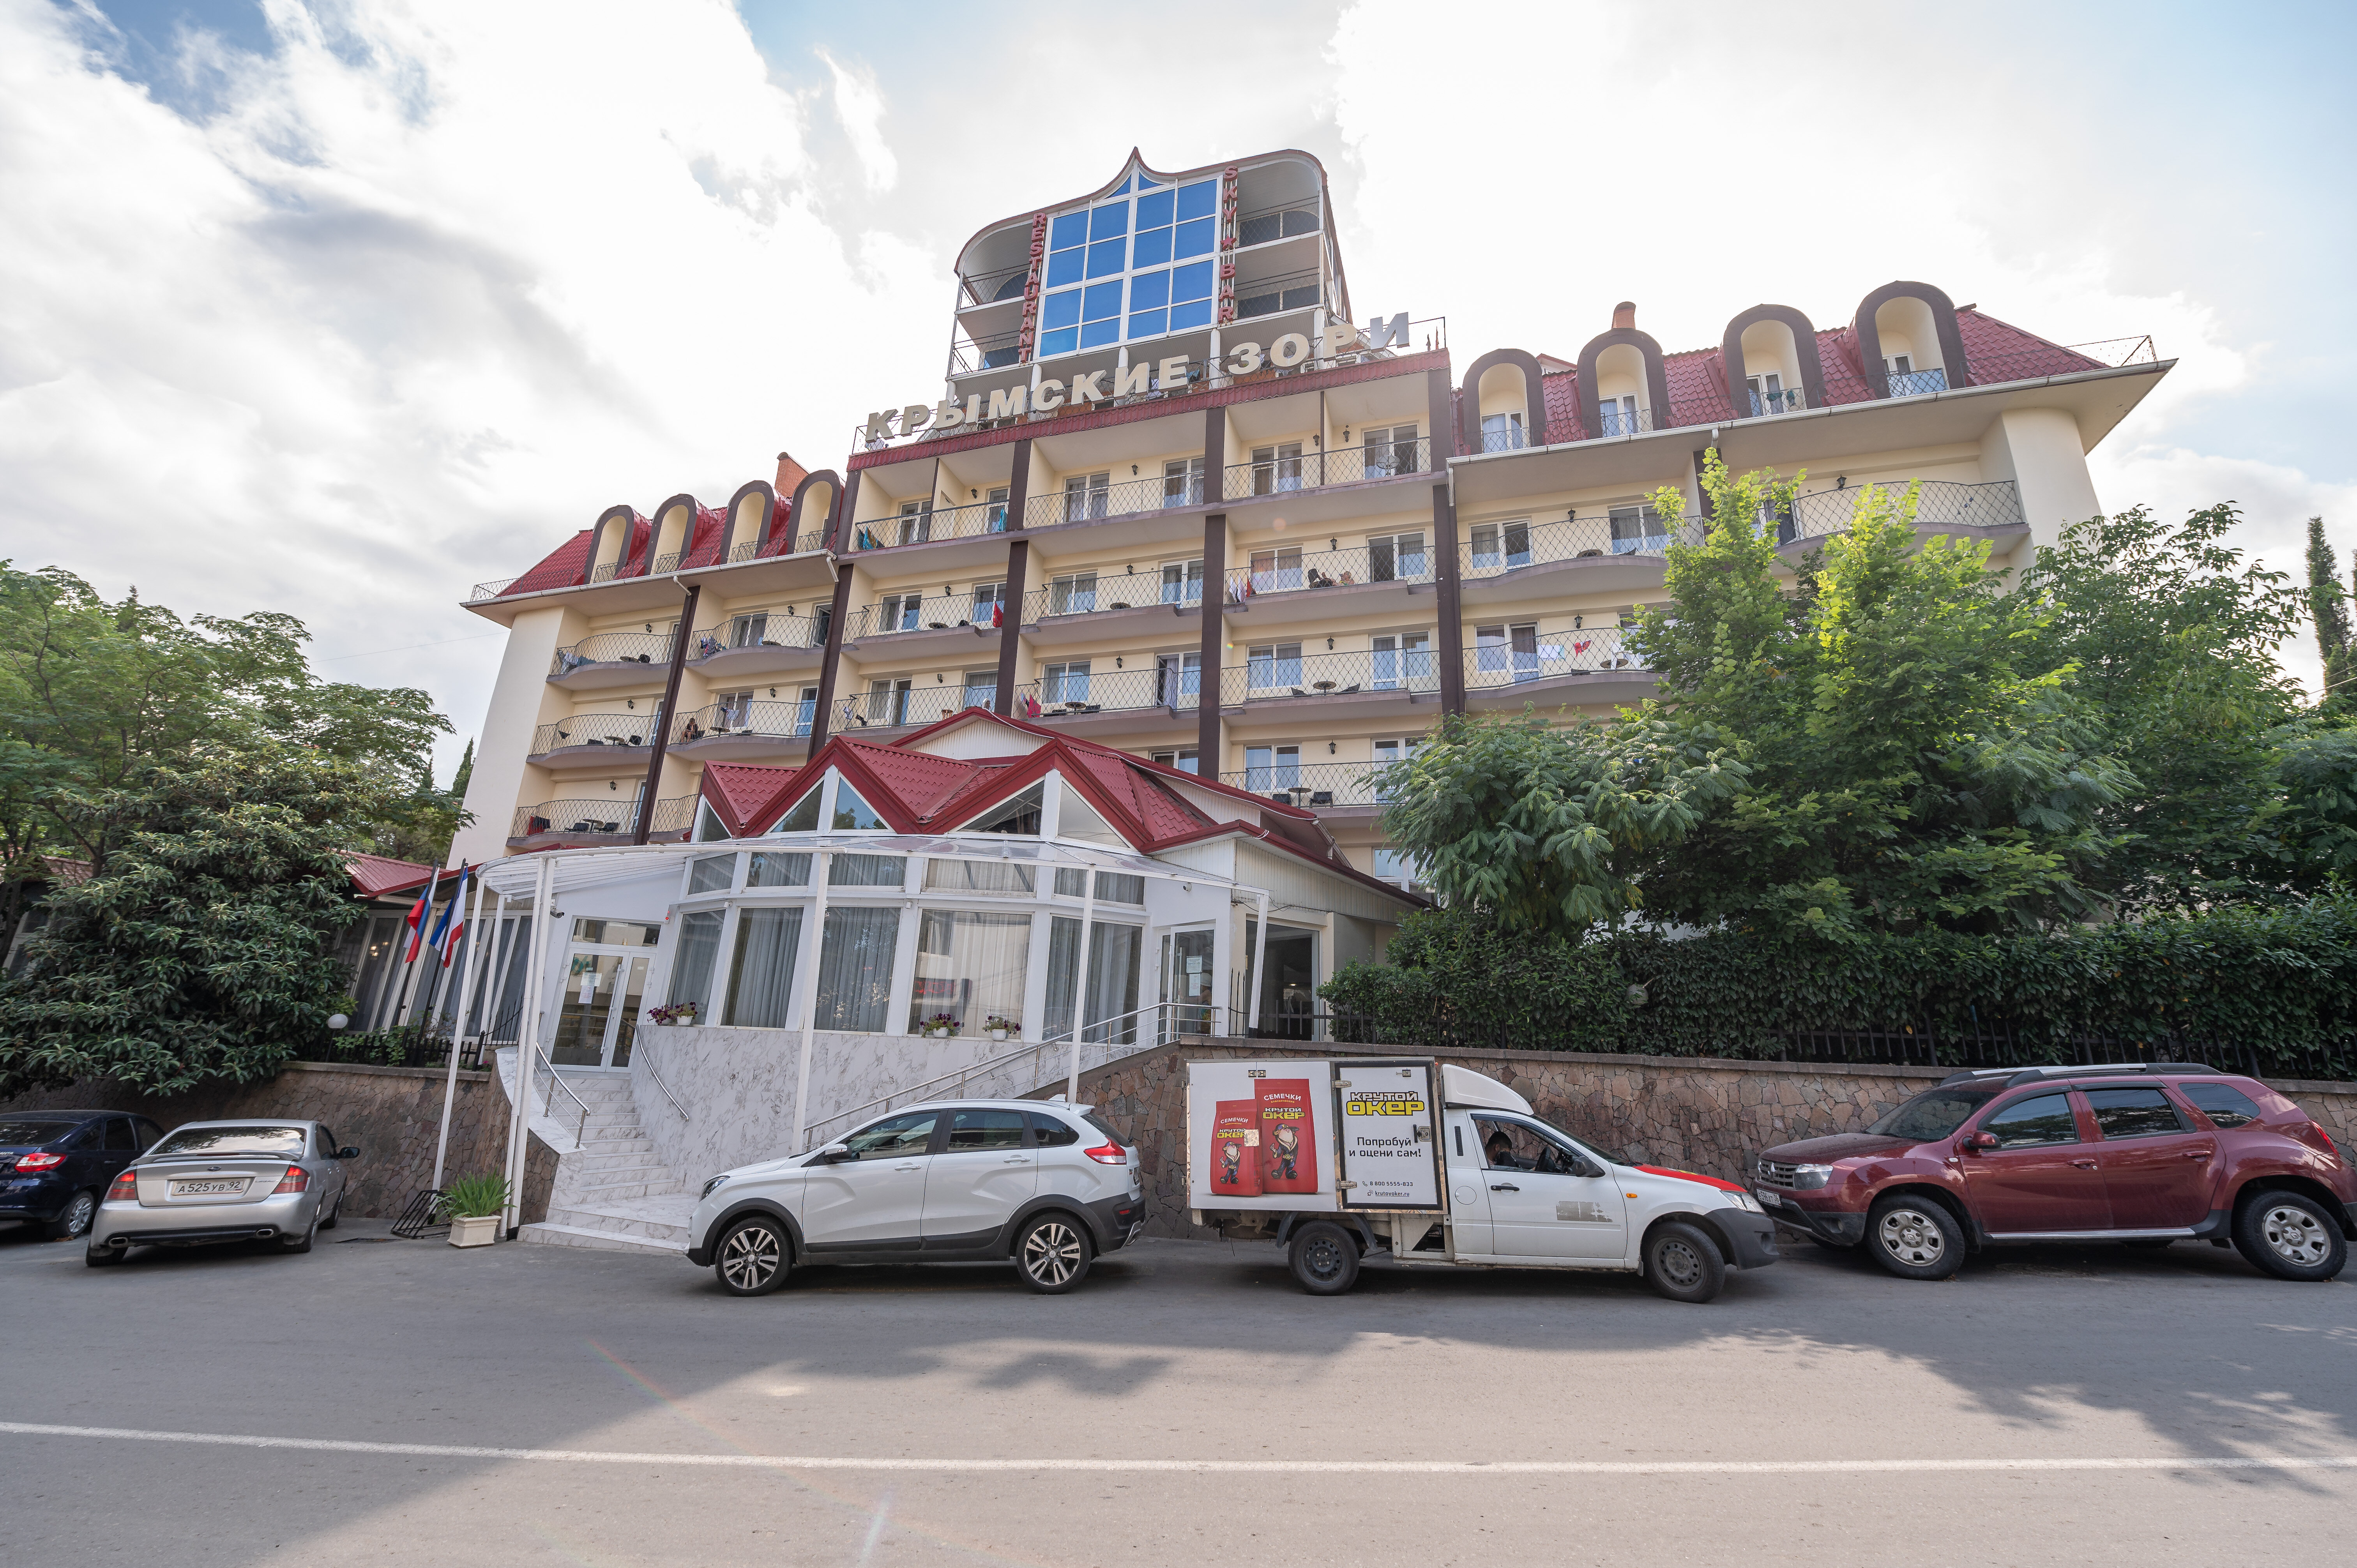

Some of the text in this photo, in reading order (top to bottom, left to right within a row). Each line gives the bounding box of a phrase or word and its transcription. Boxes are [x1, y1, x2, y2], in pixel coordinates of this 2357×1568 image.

[1218, 165, 1238, 323] SKY BAR
[1018, 212, 1046, 363] RESTAURANT
[866, 312, 1410, 443] КРЫМСКИЕ ЗОРИ
[1263, 1093, 1301, 1101] СЕМЕЧКИ
[1350, 1091, 1418, 1101] КРУТОЙ
[1357, 1137, 1412, 1148] Попробуй
[1397, 1149, 1422, 1157] сам!
